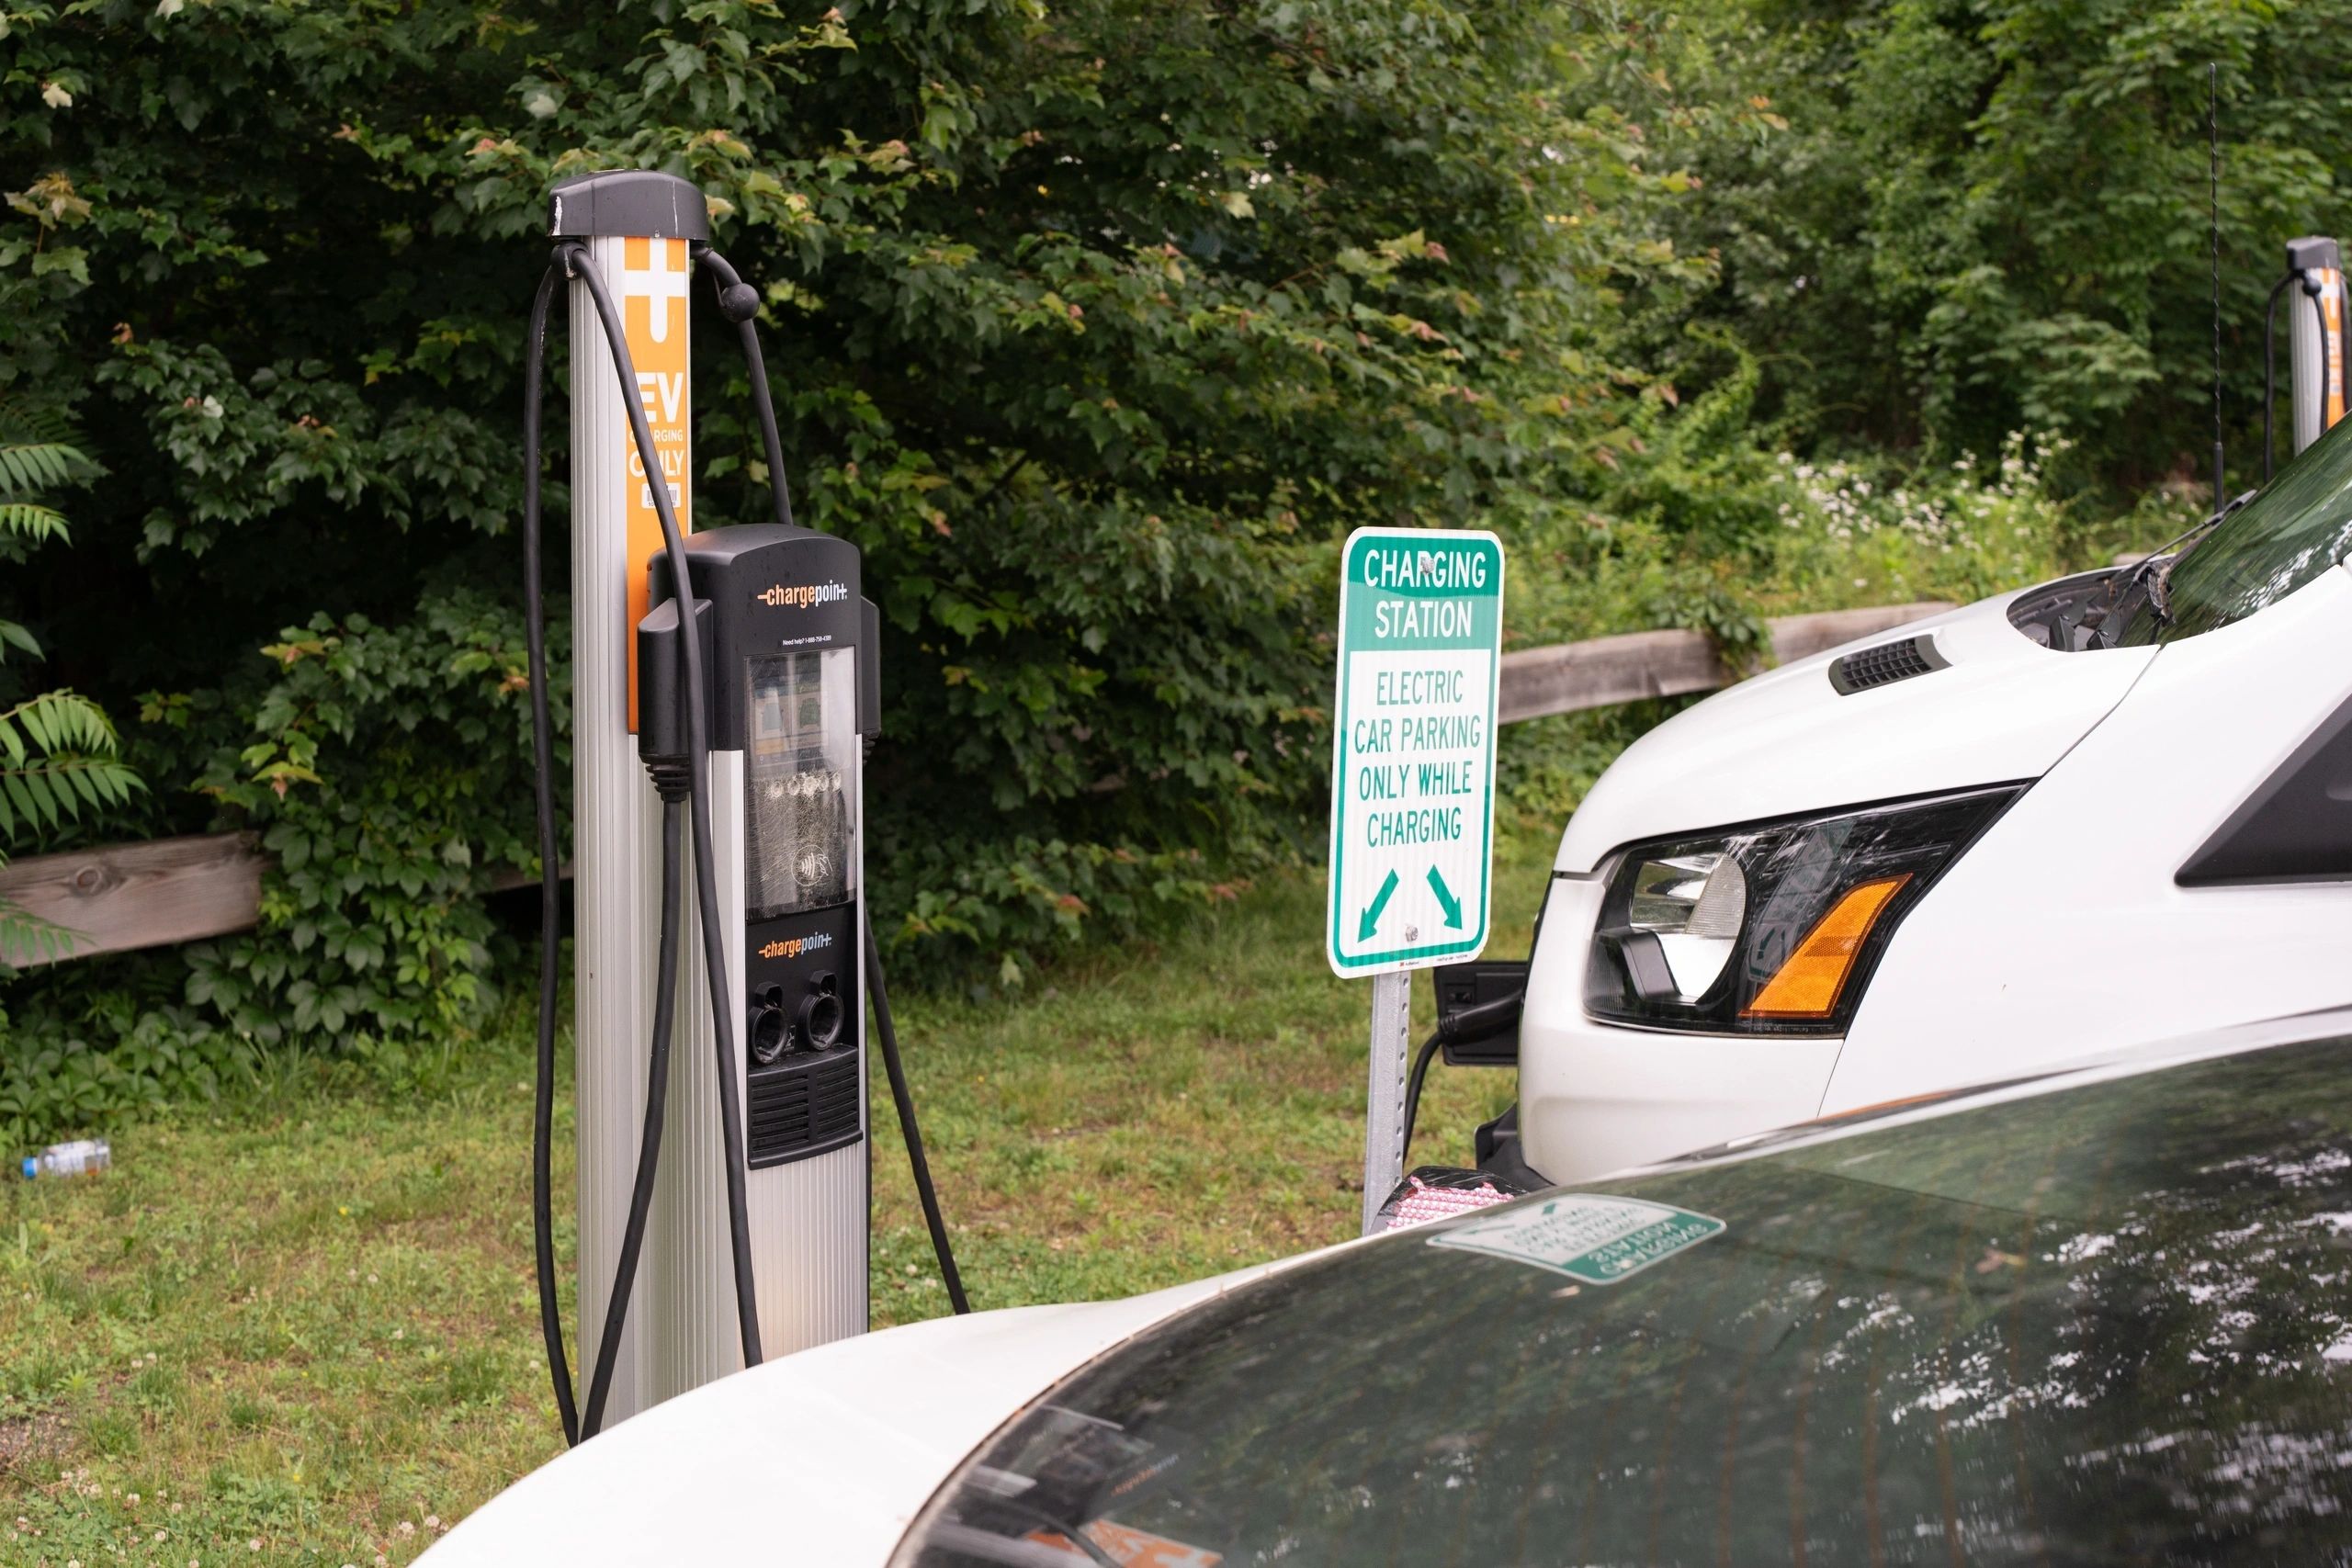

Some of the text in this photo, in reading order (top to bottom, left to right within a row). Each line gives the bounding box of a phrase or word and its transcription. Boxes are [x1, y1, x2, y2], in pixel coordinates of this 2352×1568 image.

[635, 371, 684, 423] EV
[1363, 548, 1487, 589] CHARGING
[1374, 600, 1473, 639] STATION
[1376, 669, 1464, 706] ELECTRIC
[1354, 715, 1481, 754] CAR PARKING
[1359, 761, 1473, 801] ONLY WHILE
[1367, 807, 1462, 848] CHARGING
